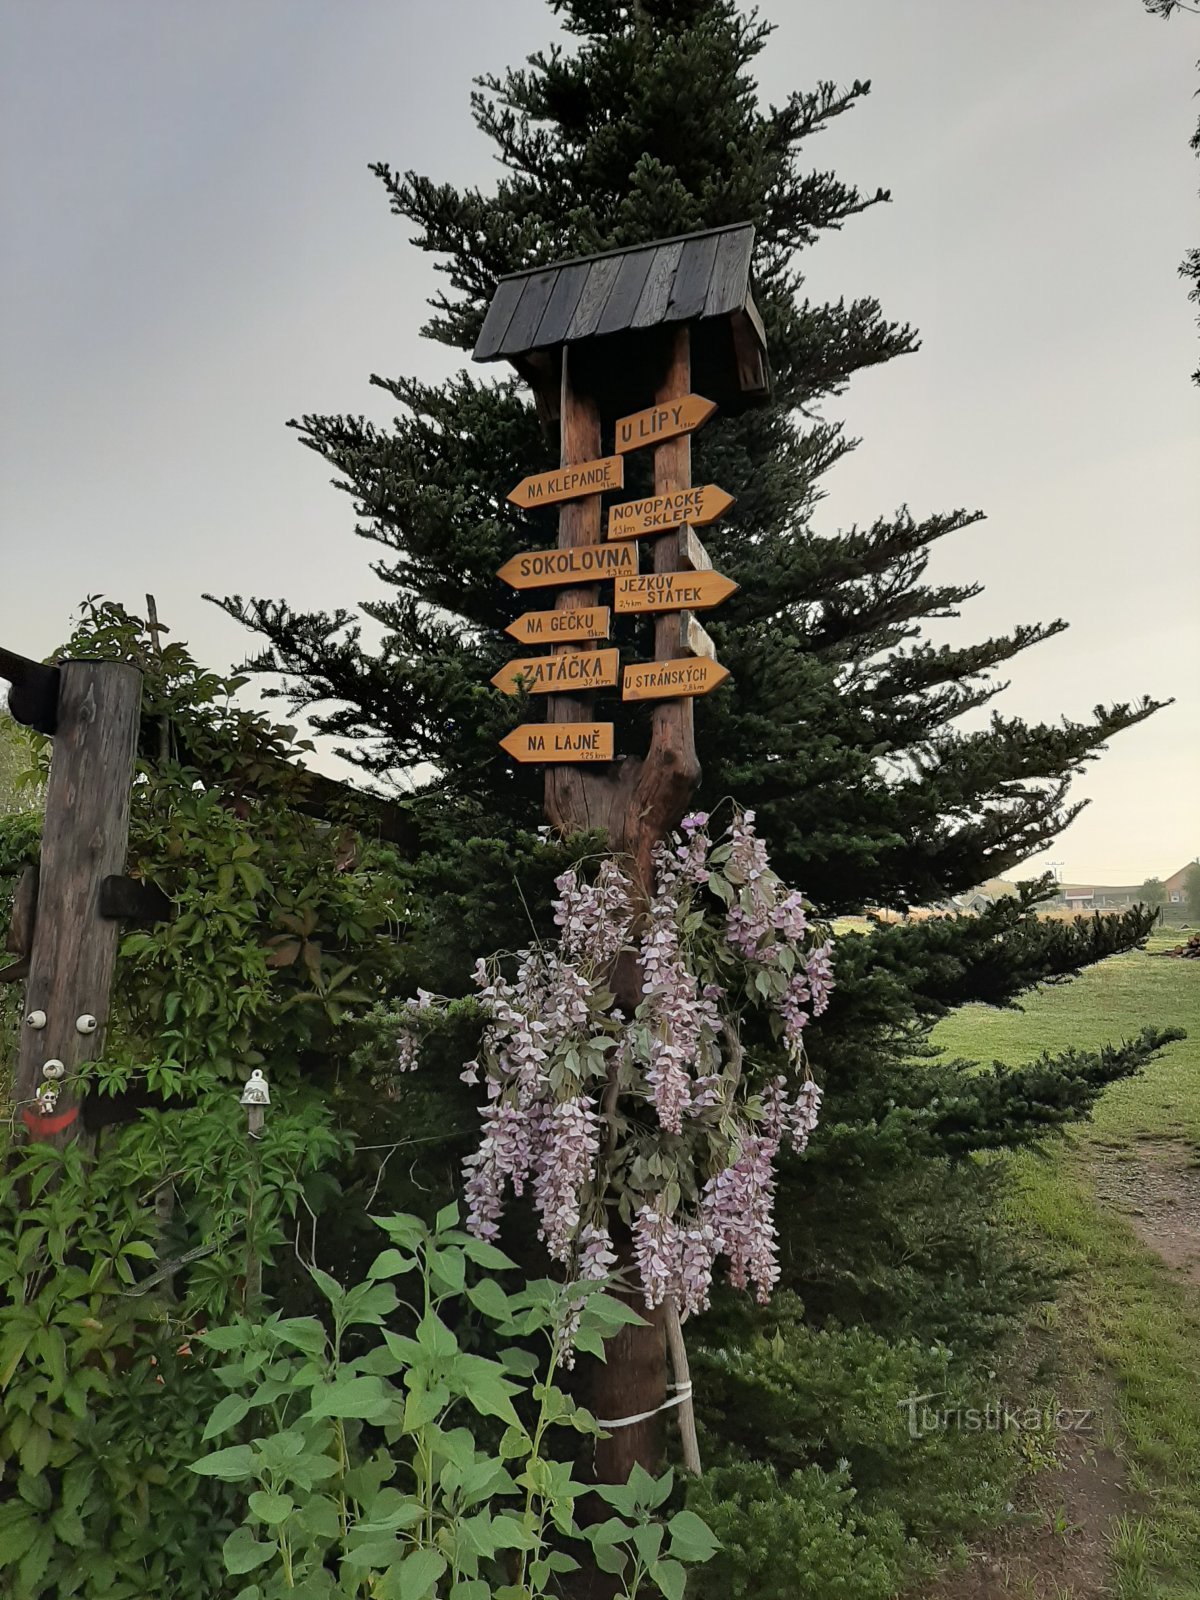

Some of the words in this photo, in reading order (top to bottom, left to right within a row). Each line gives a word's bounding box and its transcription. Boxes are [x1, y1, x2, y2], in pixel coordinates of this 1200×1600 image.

[622, 423, 632, 442] U
[640, 405, 682, 437] LÍPY
[528, 482, 543, 499] NA
[548, 462, 612, 493] KLEPANDĚ
[614, 487, 704, 520] NOVOPACKÉ
[643, 505, 703, 527] SKLEPY
[520, 547, 632, 577] SOKOLOVNA
[619, 573, 674, 592] JEŽKŮV
[647, 587, 702, 604] STATEK
[527, 618, 543, 633] NA
[523, 656, 603, 684] ZATÁČKA
[624, 677, 632, 689] U
[636, 665, 707, 688] STRÁNSKÝCH
[528, 735, 545, 751] NA
[555, 729, 600, 751] LAJNĚ
